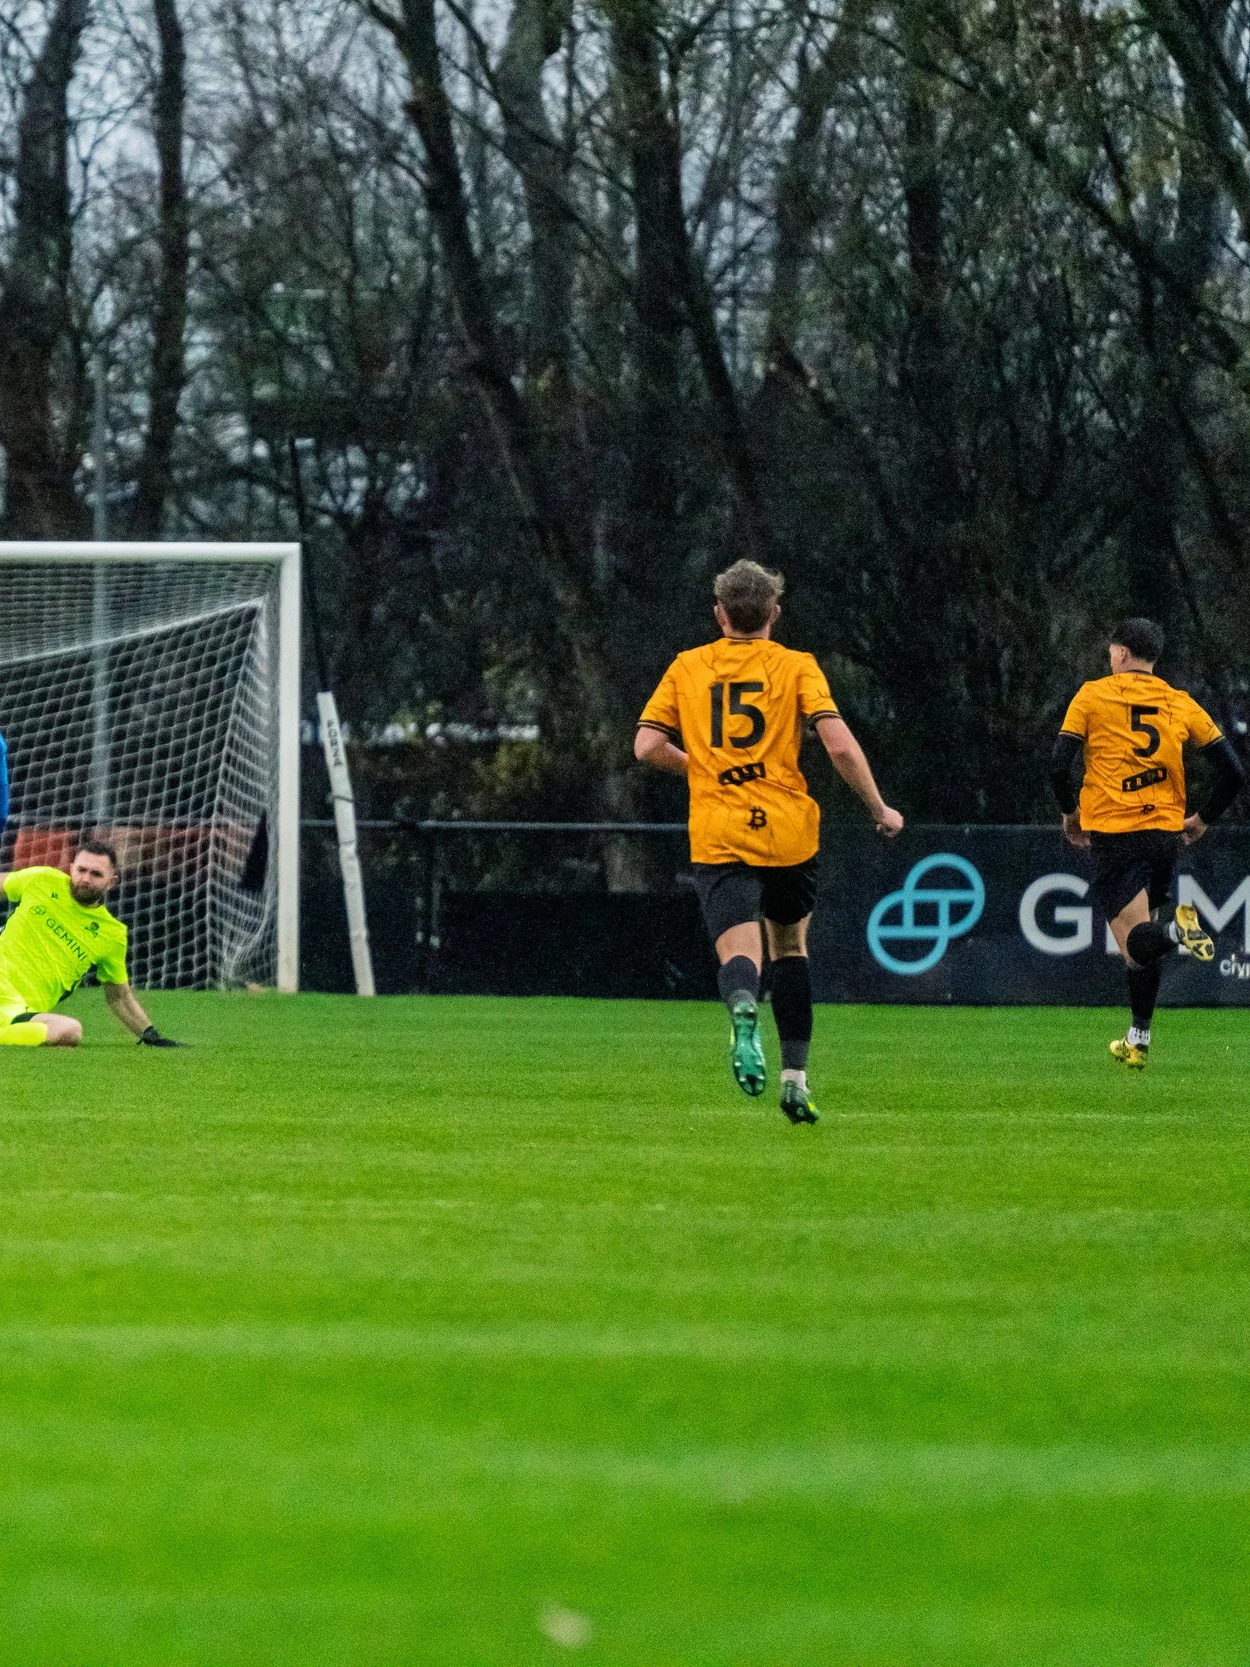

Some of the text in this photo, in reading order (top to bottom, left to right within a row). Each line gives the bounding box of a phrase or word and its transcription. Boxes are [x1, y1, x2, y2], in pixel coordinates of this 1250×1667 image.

[710, 682, 766, 749] 15
[1130, 704, 1160, 757] 5
[46, 918, 88, 962] GEMINI
[1019, 872, 1250, 956] GM
